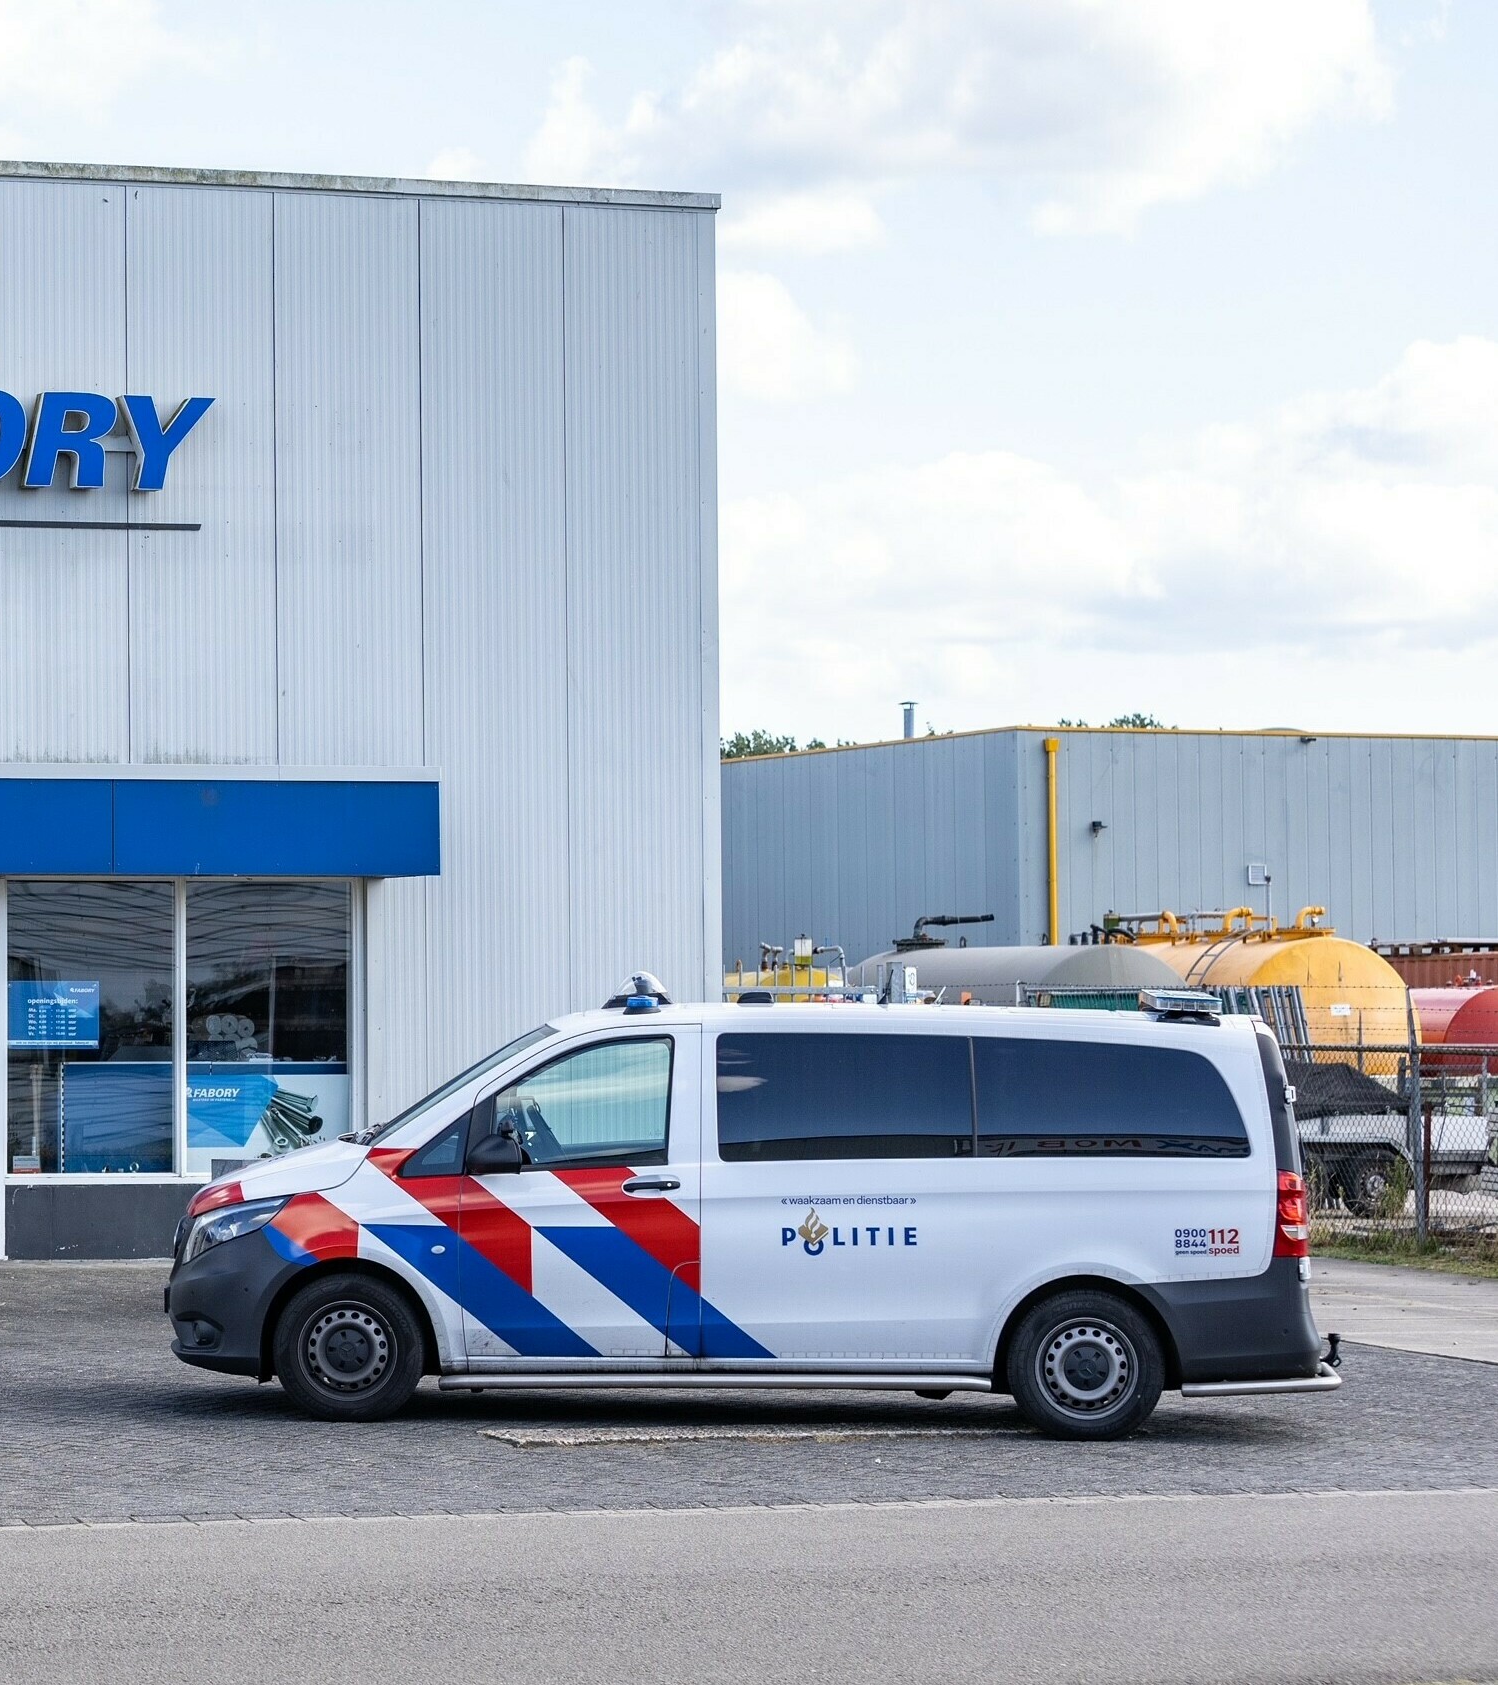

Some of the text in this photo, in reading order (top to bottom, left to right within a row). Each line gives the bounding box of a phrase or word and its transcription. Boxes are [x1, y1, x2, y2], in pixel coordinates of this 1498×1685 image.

[28, 998, 78, 1006] openingstijden:
[194, 1088, 240, 1098] FABORY
[790, 1196, 841, 1205] waakzaam
[857, 1196, 908, 1204] dienstbaar
[1174, 1228, 1206, 1238] 0900
[1208, 1228, 1239, 1244] 112
[782, 1226, 917, 1256] POLITIE
[1175, 1239, 1206, 1248] 8844
[1208, 1246, 1240, 1256] spoed
